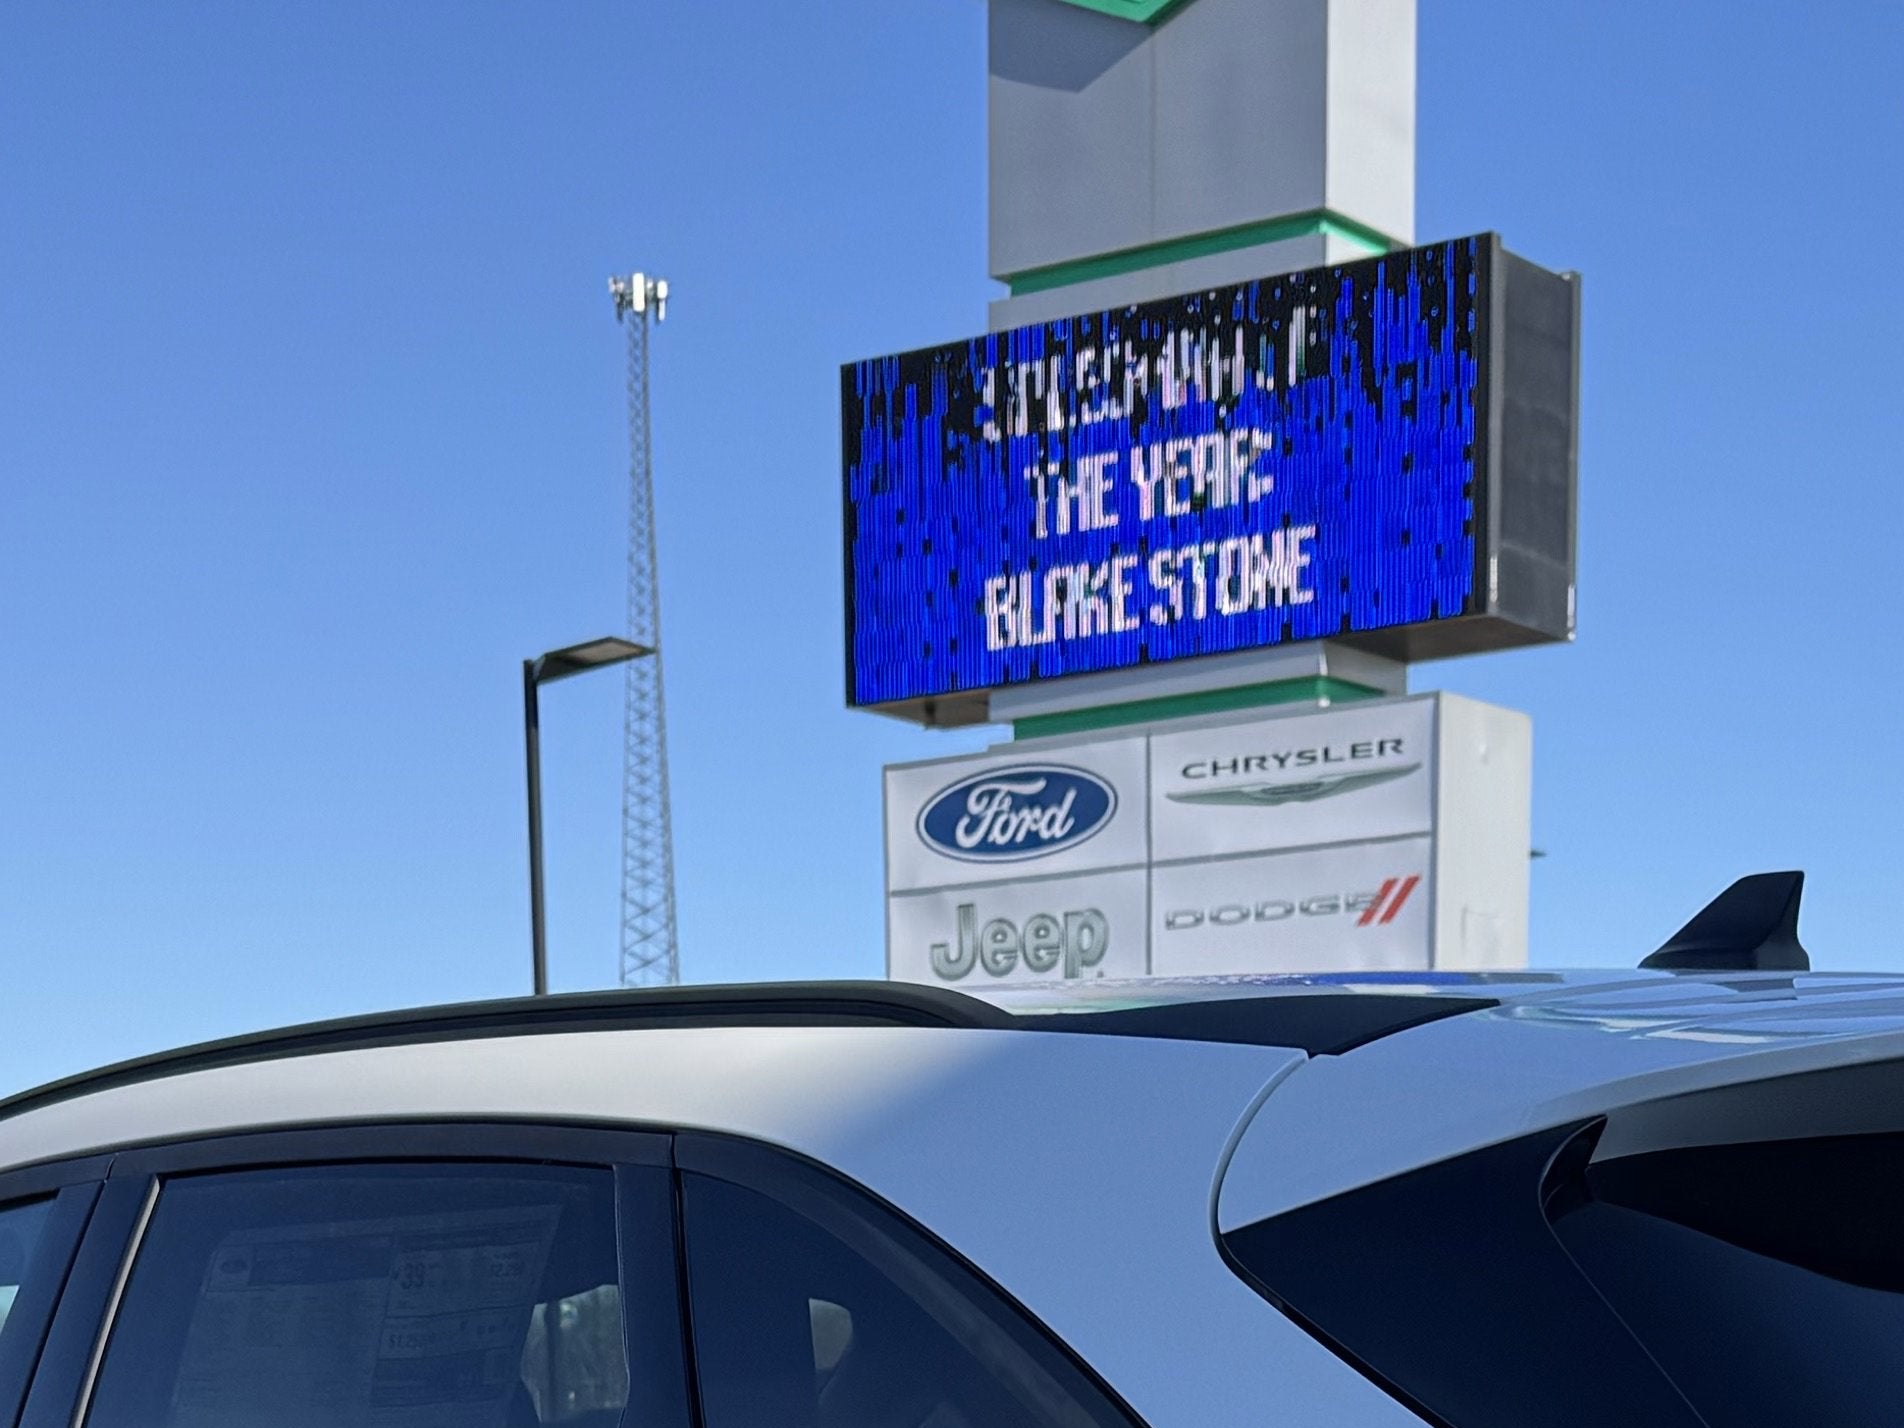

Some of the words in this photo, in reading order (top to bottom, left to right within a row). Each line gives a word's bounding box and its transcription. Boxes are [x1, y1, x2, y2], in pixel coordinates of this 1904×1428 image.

[1024, 452, 1118, 540] THE
[984, 554, 1140, 651] BLAKE
[1181, 737, 1405, 779] CHRYSLER
[954, 776, 1077, 849] Ford
[929, 901, 1110, 981] Jeep
[1164, 890, 1382, 931] DODGE
